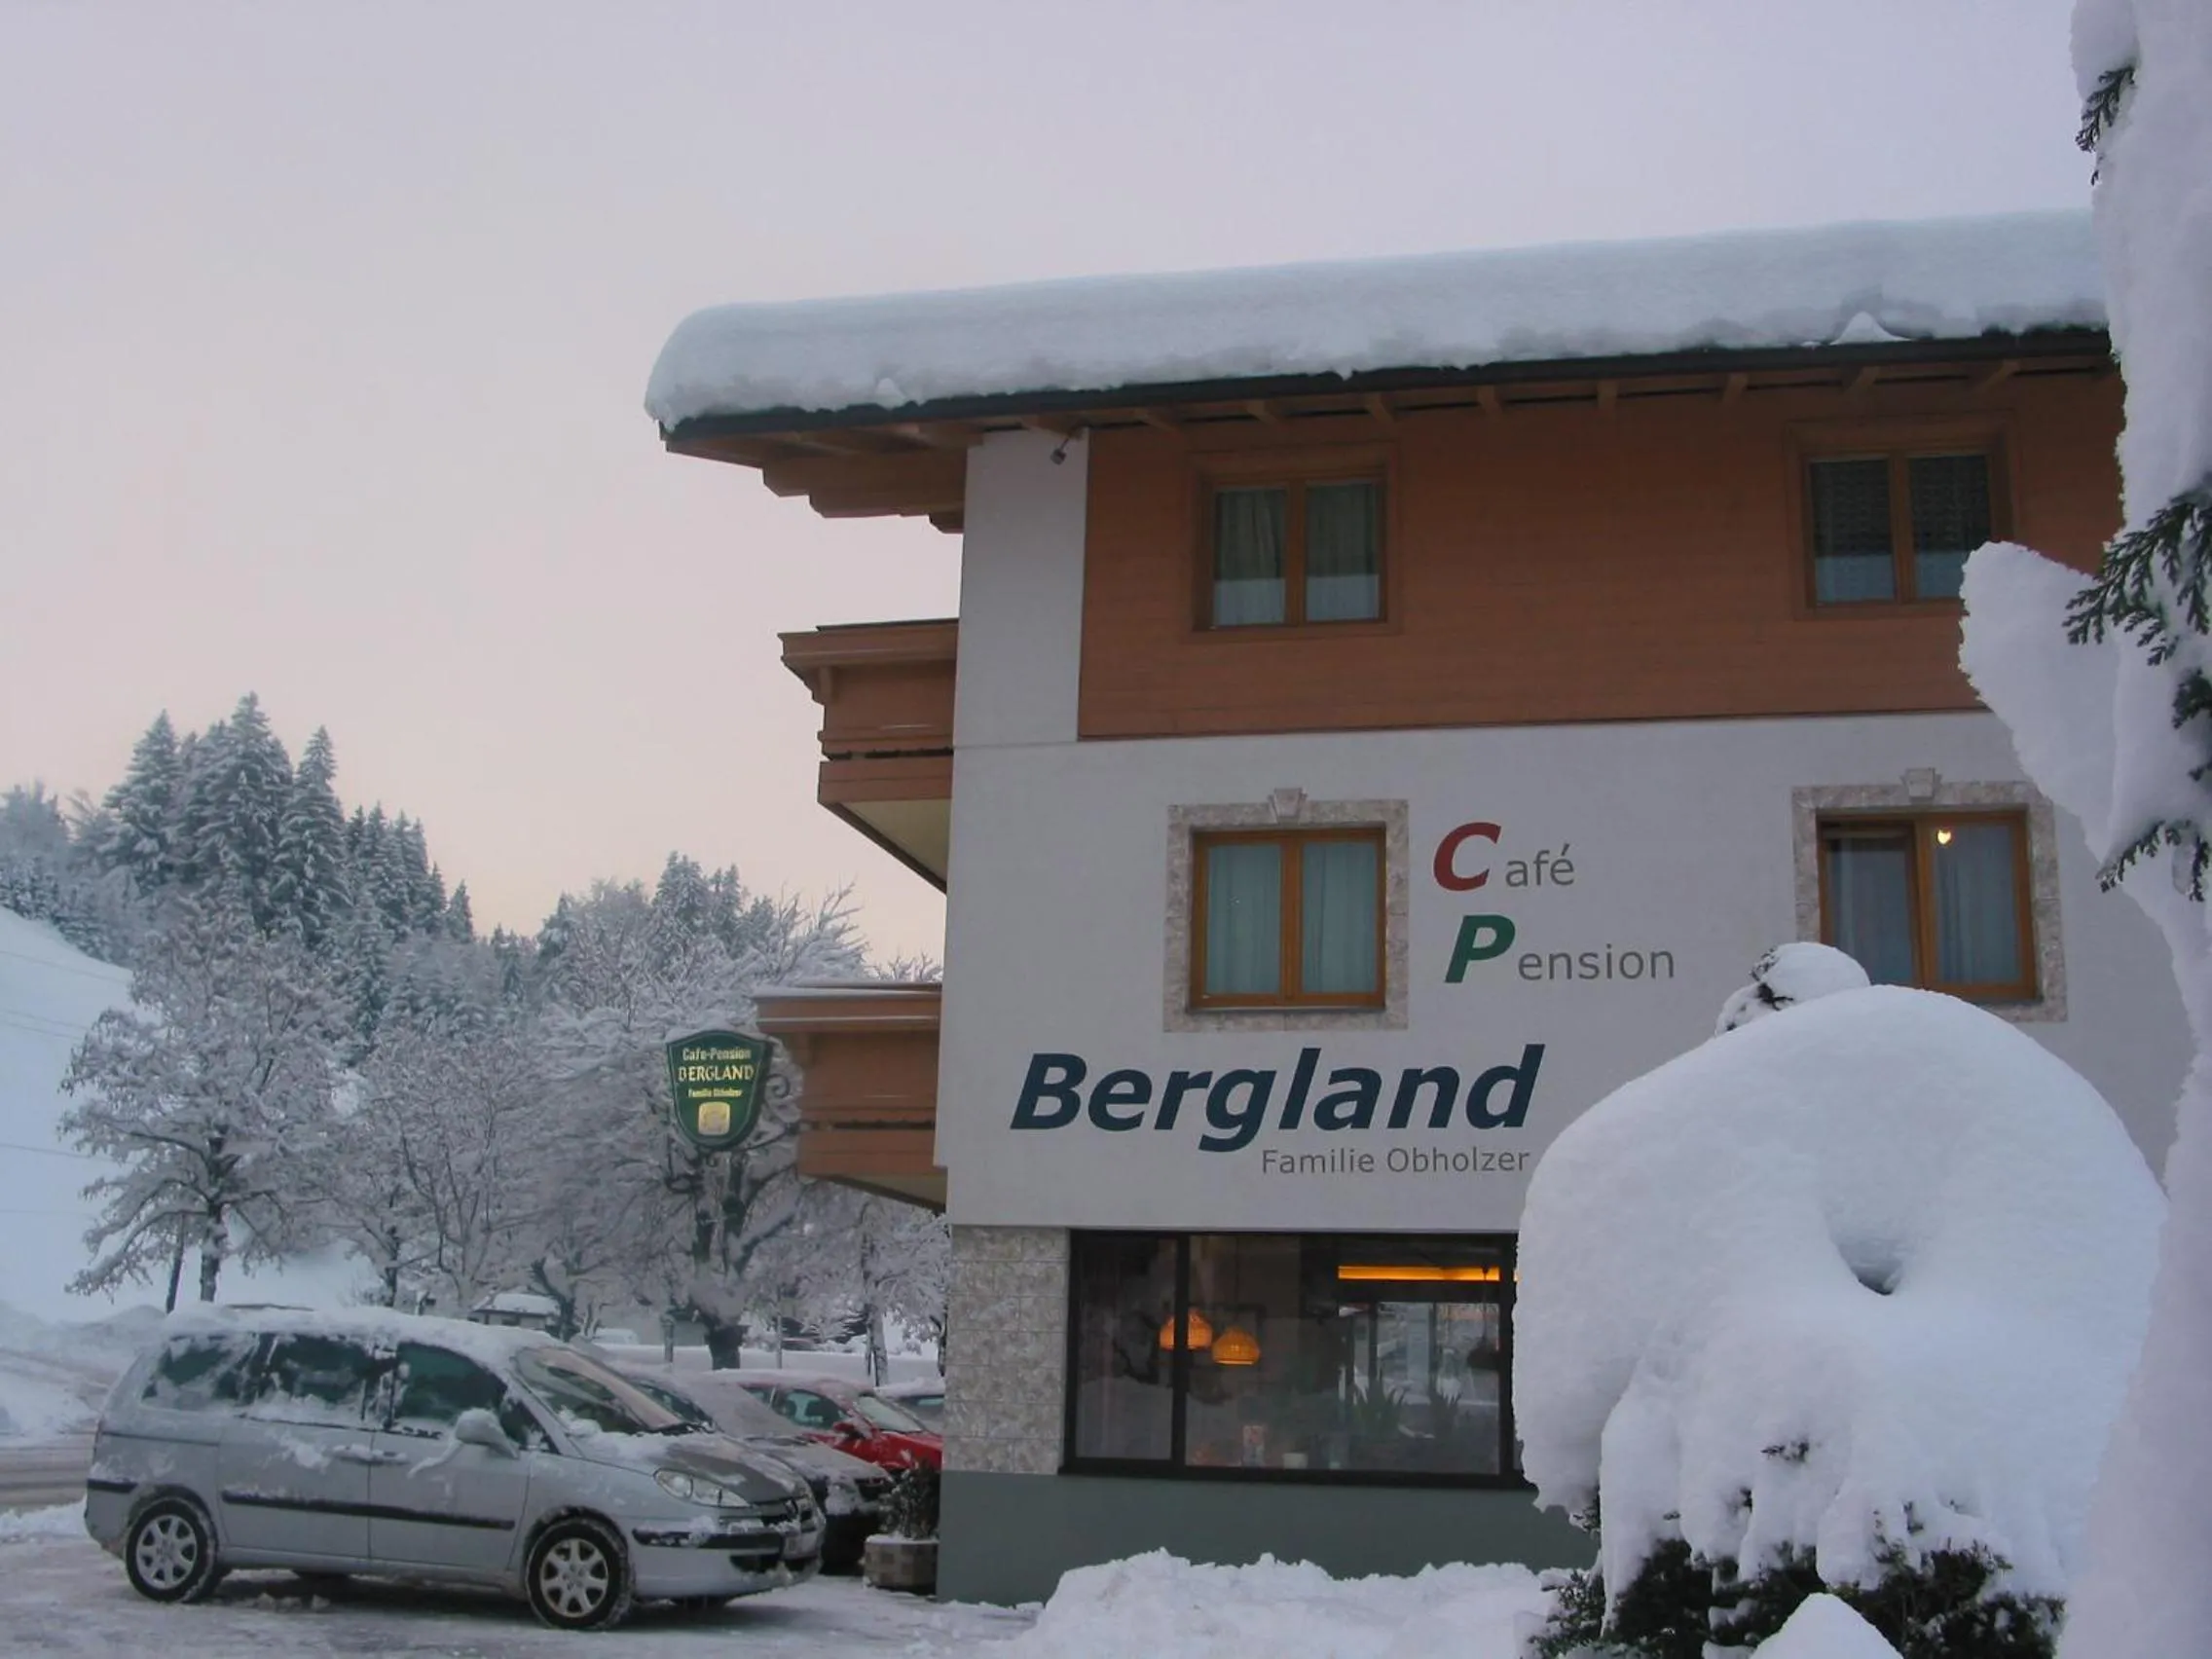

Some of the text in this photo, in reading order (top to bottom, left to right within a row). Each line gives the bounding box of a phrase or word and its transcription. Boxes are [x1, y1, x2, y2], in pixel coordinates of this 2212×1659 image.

[1433, 821, 1575, 892] Café
[1445, 915, 1675, 983] Pension
[679, 1065, 754, 1081] BERGLAND
[1010, 1044, 1545, 1153] Bergland
[1262, 1147, 1530, 1174] Familie Obholzer
